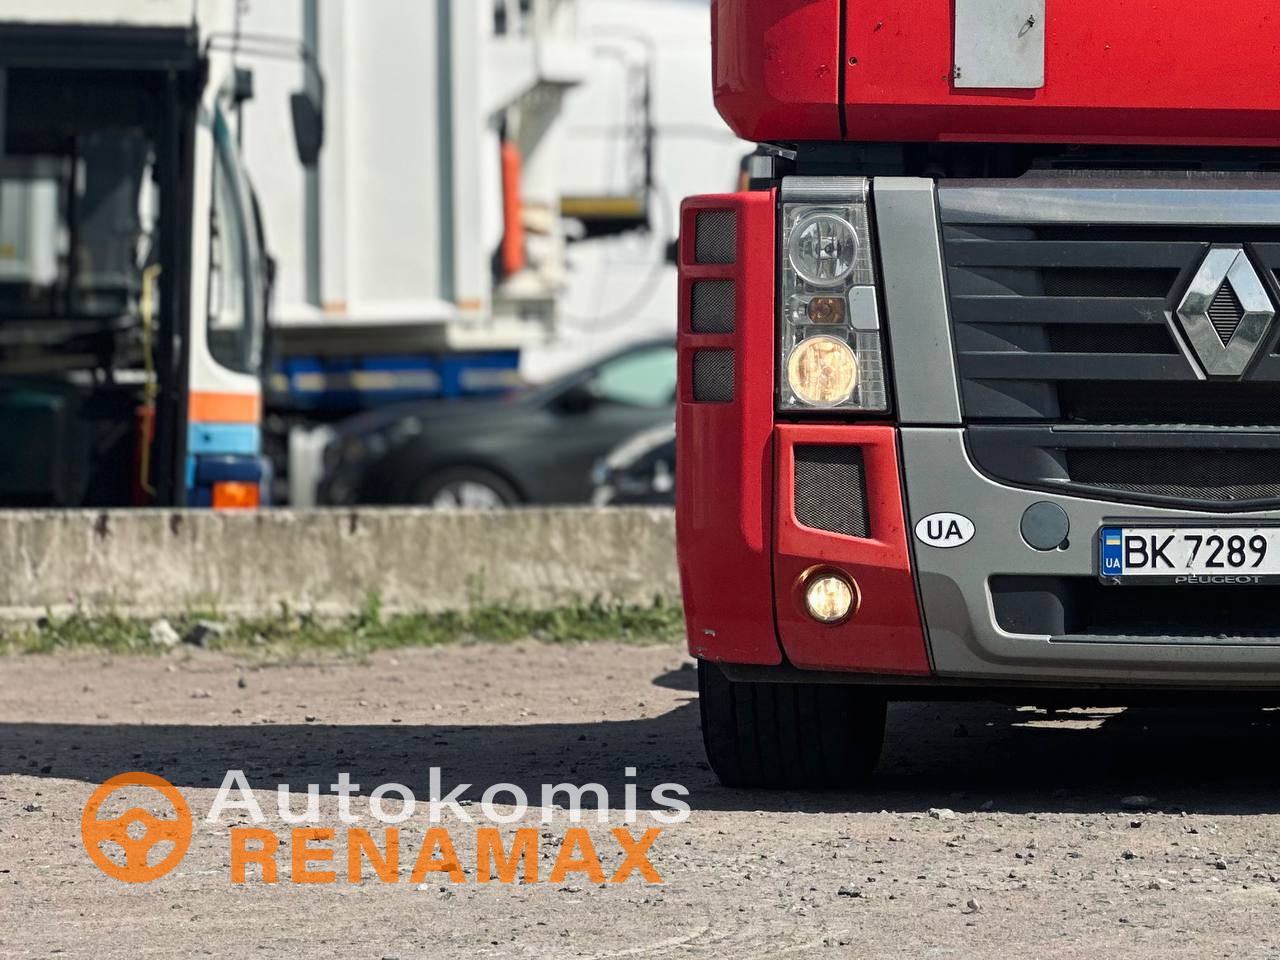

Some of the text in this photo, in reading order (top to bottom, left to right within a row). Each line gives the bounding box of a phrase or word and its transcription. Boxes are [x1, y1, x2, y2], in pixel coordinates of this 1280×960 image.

[927, 521, 963, 539] UA
[1124, 535, 1176, 568] BK
[1184, 534, 1268, 568] 7289
[1105, 557, 1121, 569] UA
[1175, 575, 1263, 585] PEUGEOT
